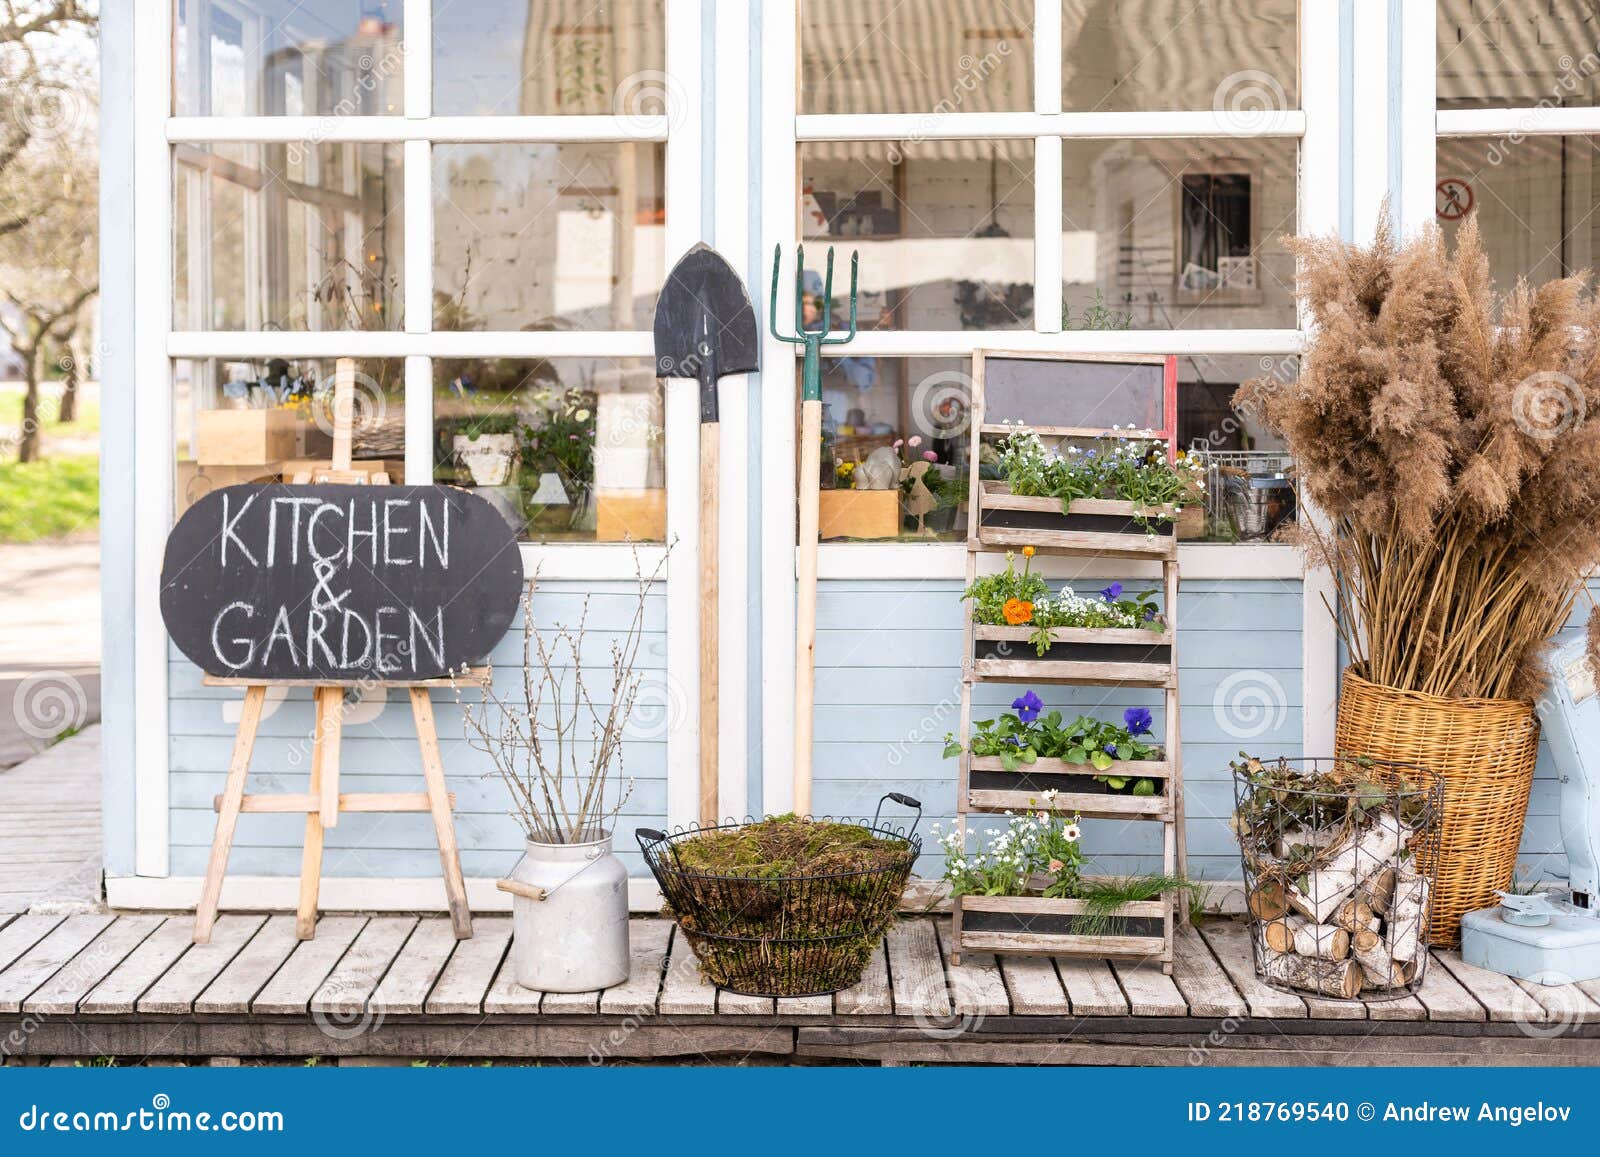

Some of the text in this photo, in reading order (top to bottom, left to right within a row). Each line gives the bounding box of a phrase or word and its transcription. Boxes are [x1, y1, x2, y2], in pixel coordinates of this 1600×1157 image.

[221, 493, 449, 569] KITCHEN
[311, 558, 352, 612] &
[211, 601, 445, 672] GARDEN
